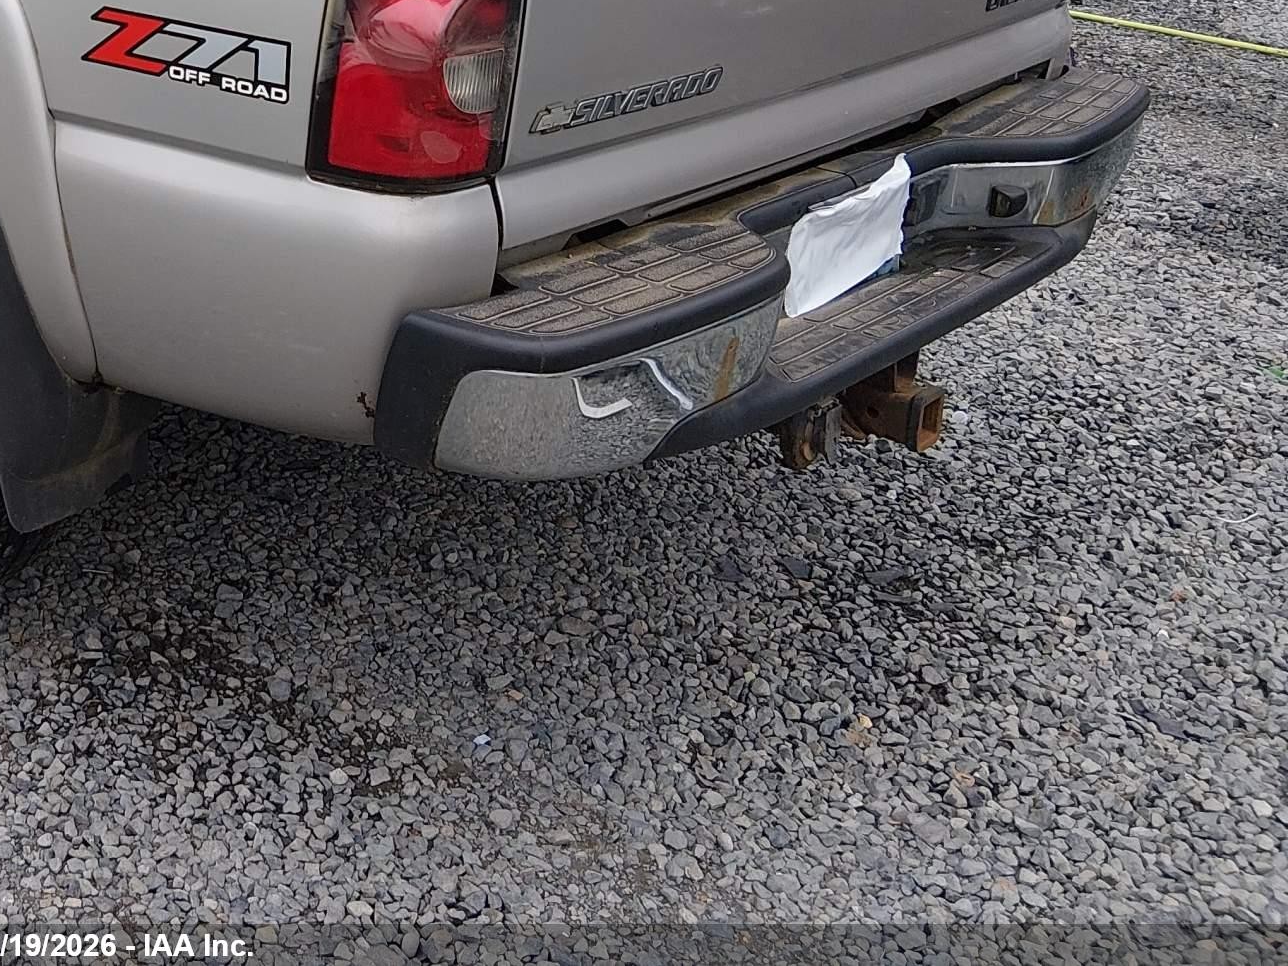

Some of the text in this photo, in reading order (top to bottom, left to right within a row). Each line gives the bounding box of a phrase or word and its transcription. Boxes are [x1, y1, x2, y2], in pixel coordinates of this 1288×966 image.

[81, 6, 292, 88] Z71
[168, 65, 288, 102] OFF ROAD
[569, 65, 723, 128] SILVERADO
